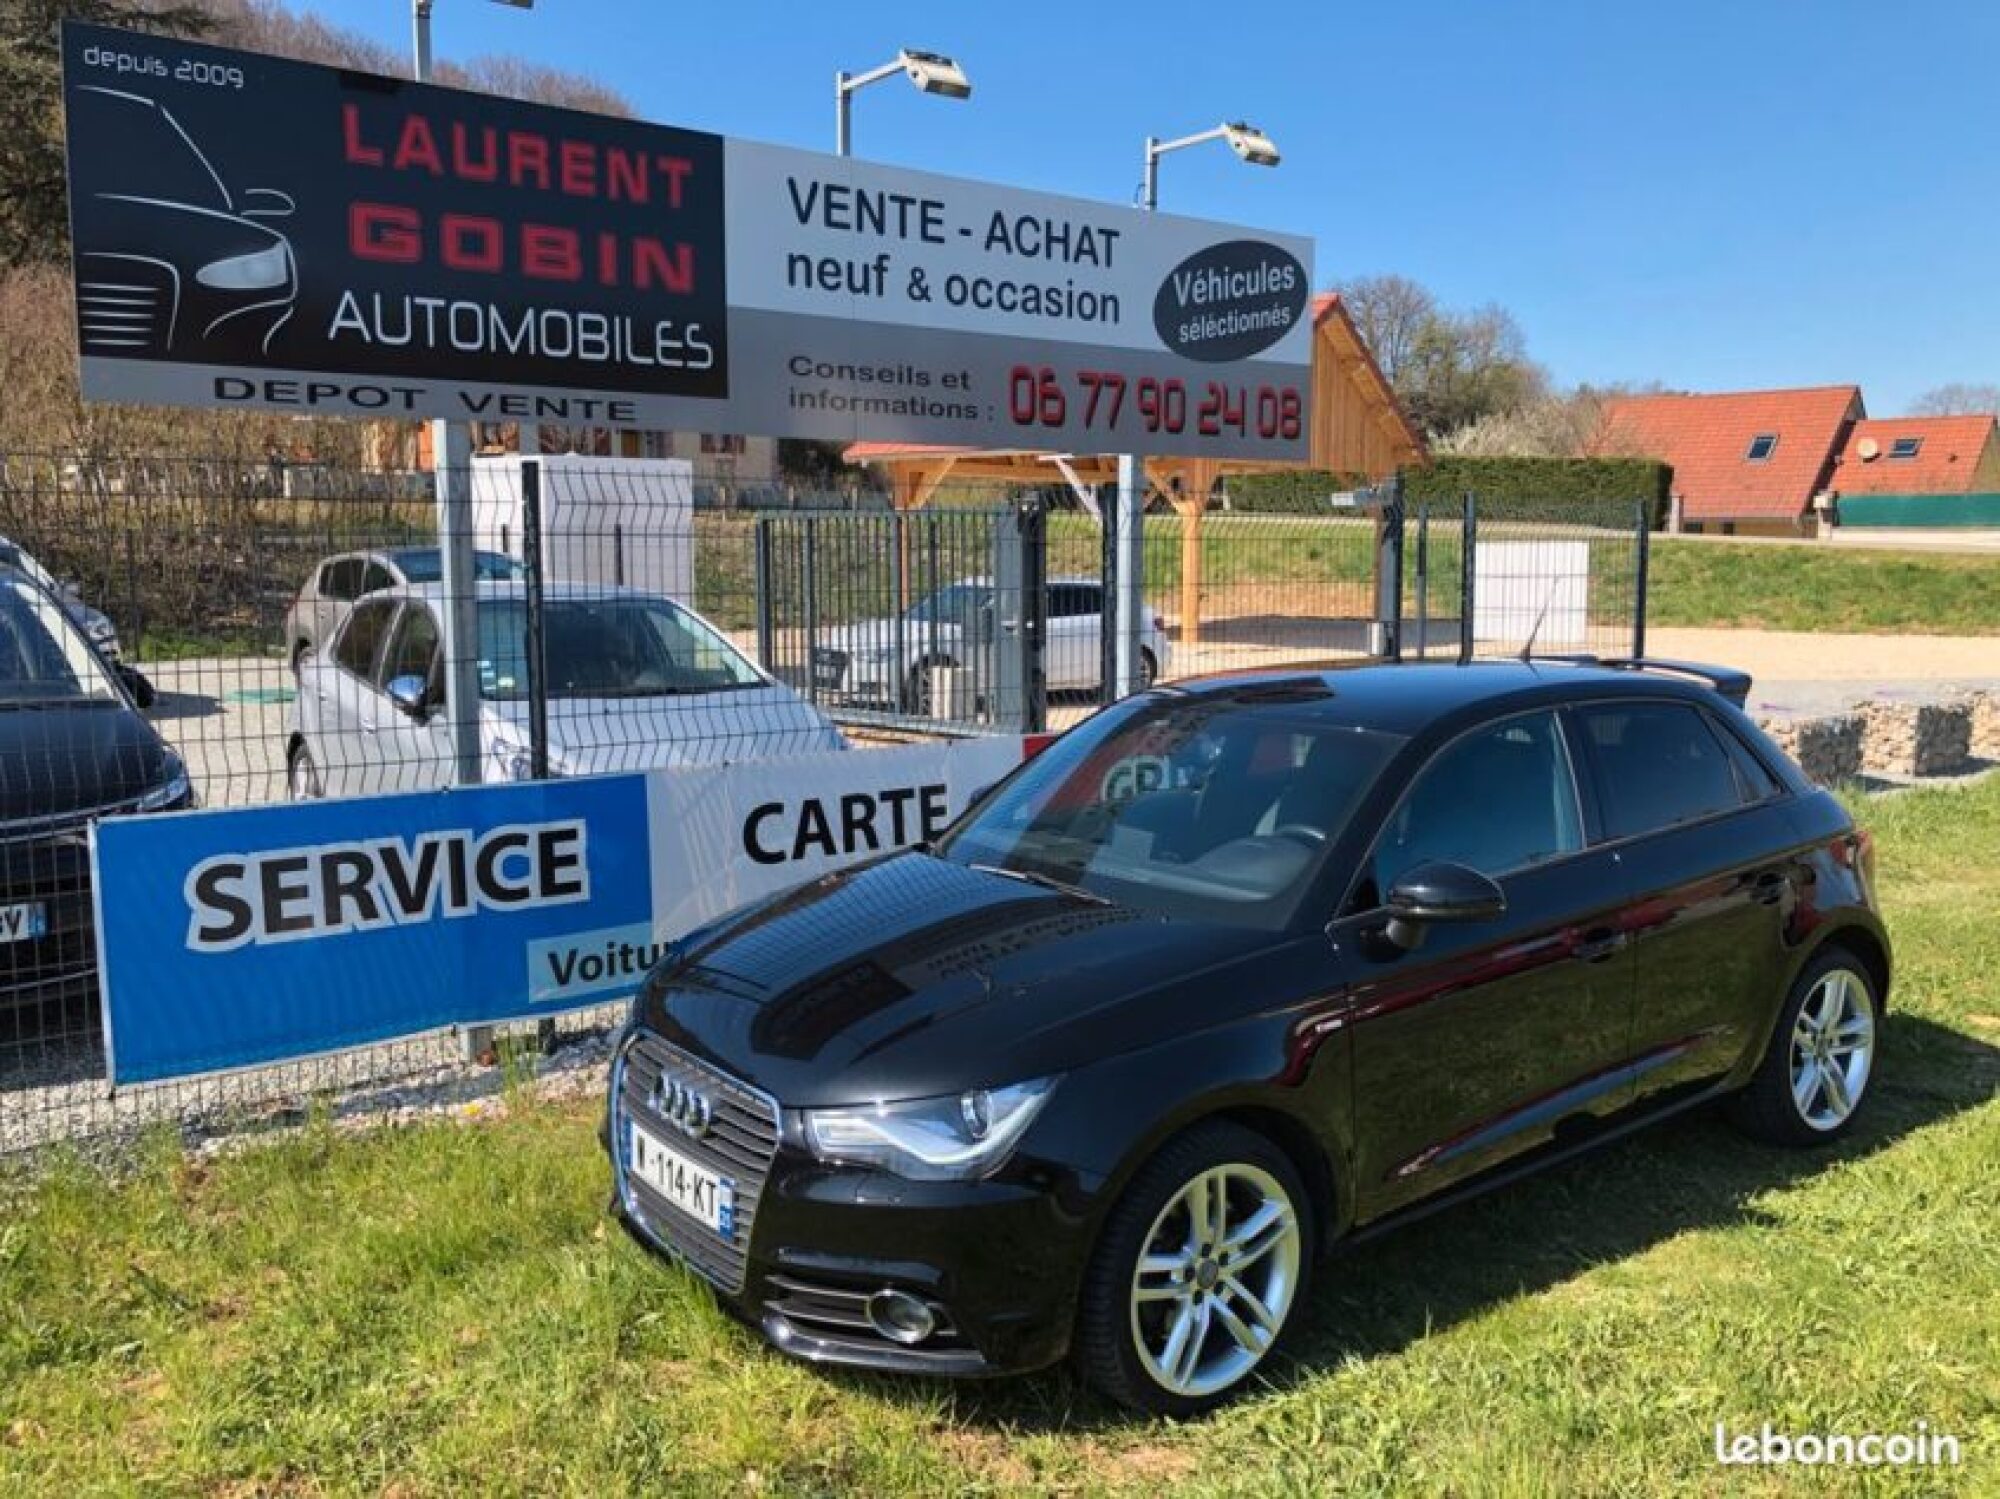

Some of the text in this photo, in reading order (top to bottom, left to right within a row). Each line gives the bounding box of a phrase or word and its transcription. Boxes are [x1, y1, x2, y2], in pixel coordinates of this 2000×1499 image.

[84, 47, 244, 89] depuis 2009
[342, 103, 694, 208] LAURENT
[349, 201, 695, 294] GOBIN
[787, 176, 946, 245] VENTE
[985, 211, 1120, 268] ACHAT
[787, 252, 1120, 324] neuf & occasion
[1173, 260, 1295, 308] Véhicules
[328, 289, 713, 369] AUTOMOBILES
[214, 376, 637, 422] DEPOT VENTE
[788, 356, 971, 391] Conseils et
[788, 387, 979, 420] informations
[1009, 365, 1302, 440] 06 77 90 24 08
[743, 783, 948, 865] CARTE
[194, 825, 584, 945] SERVICE
[0, 909, 22, 936] V
